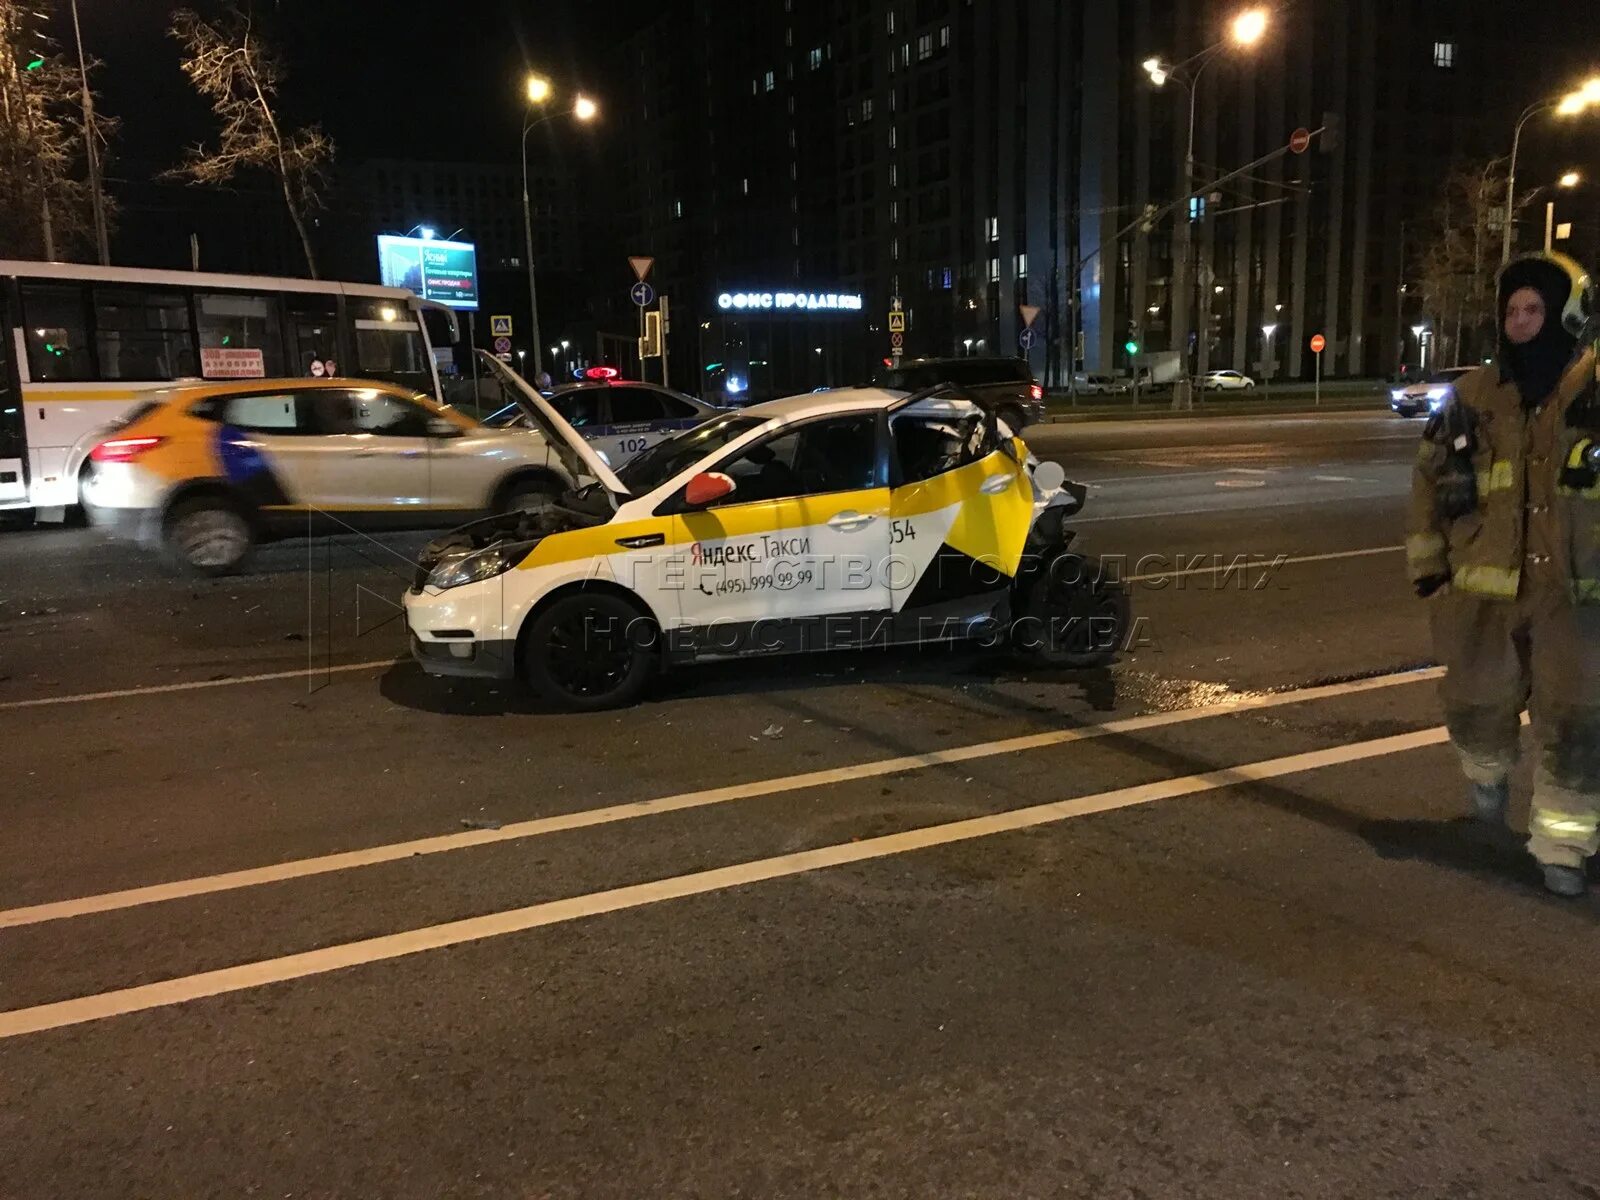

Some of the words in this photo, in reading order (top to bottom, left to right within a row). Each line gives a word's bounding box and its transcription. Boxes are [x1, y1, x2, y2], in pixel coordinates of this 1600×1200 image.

[718, 293, 773, 308] ОФИС
[205, 360, 261, 368] АЭРОПОРТ
[618, 438, 648, 453] 102
[690, 542, 757, 567] Яндекс
[760, 535, 811, 560] Такси
[751, 573, 773, 591] 999
[777, 571, 794, 588] 99
[797, 569, 813, 585] 99
